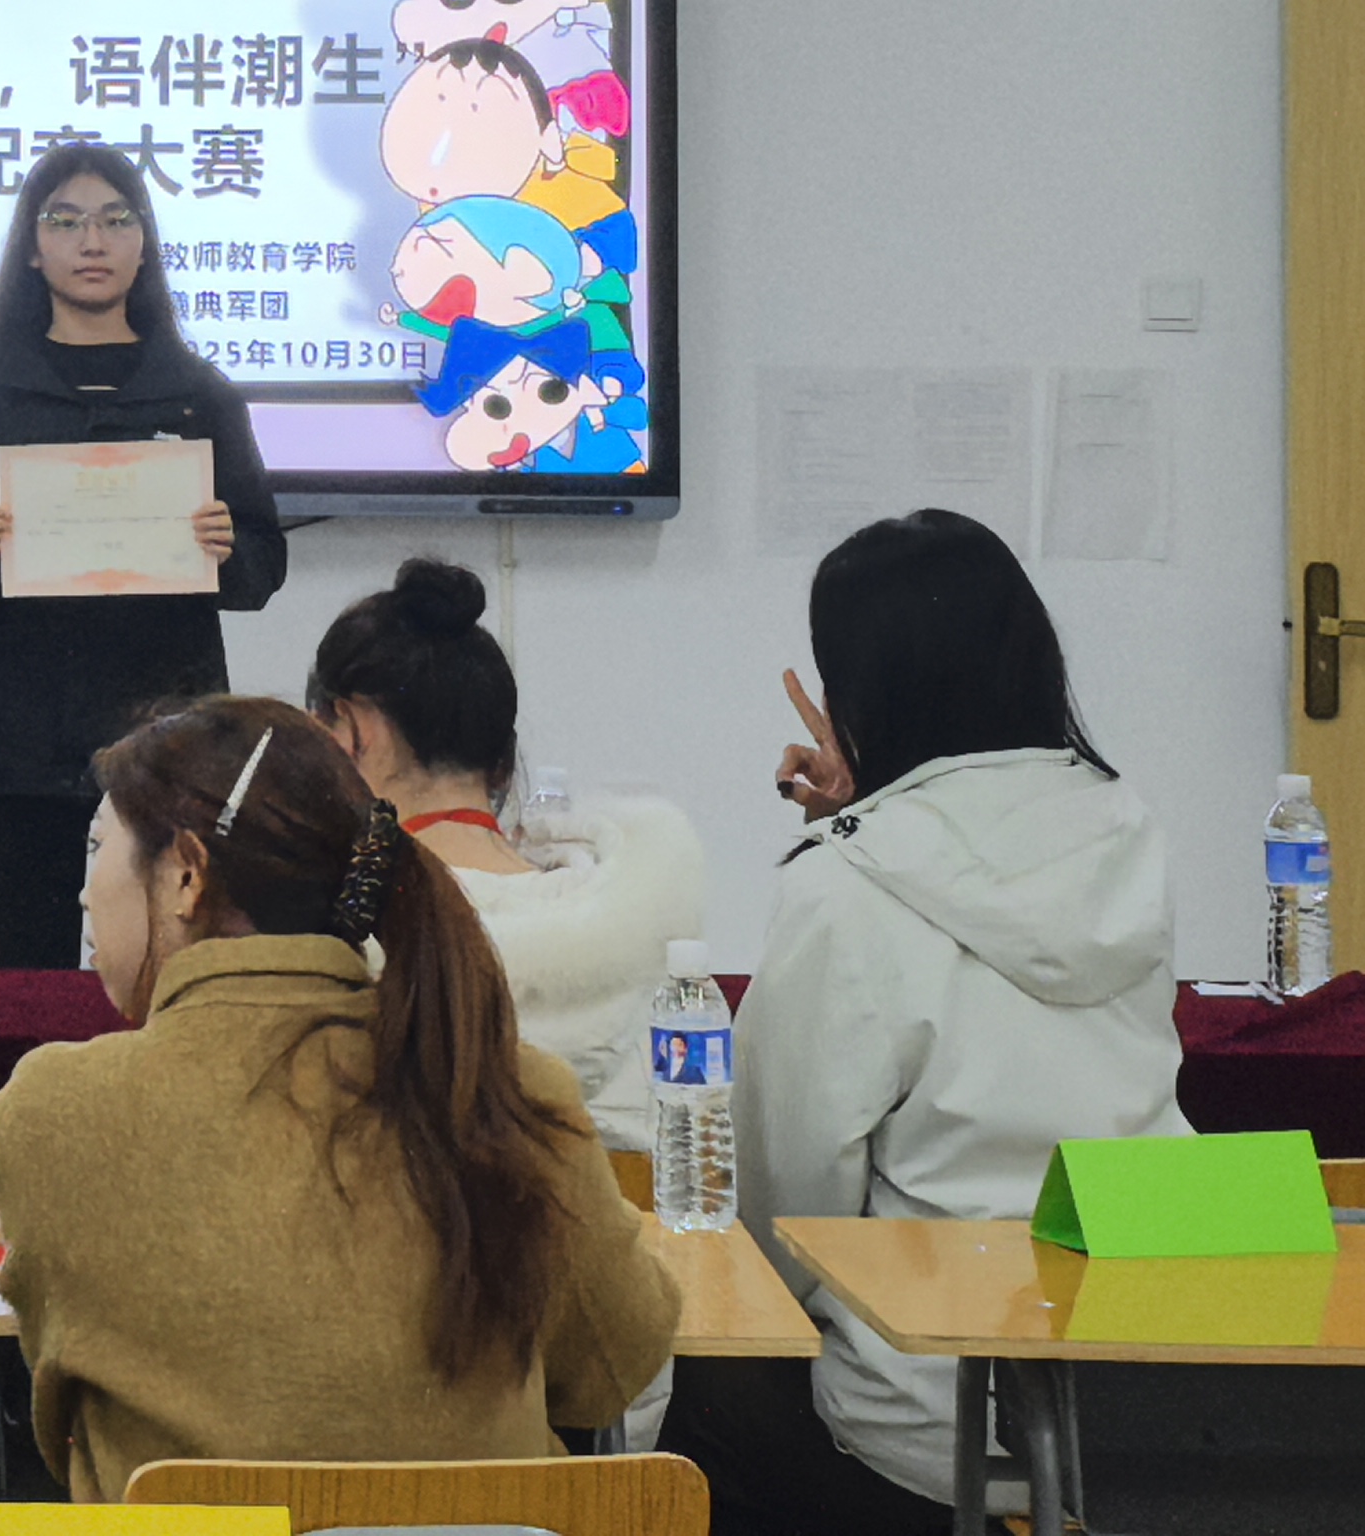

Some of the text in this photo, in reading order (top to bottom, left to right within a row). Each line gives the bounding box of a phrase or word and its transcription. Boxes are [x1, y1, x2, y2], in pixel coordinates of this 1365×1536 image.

[158, 240, 357, 272] 教师教育学院
